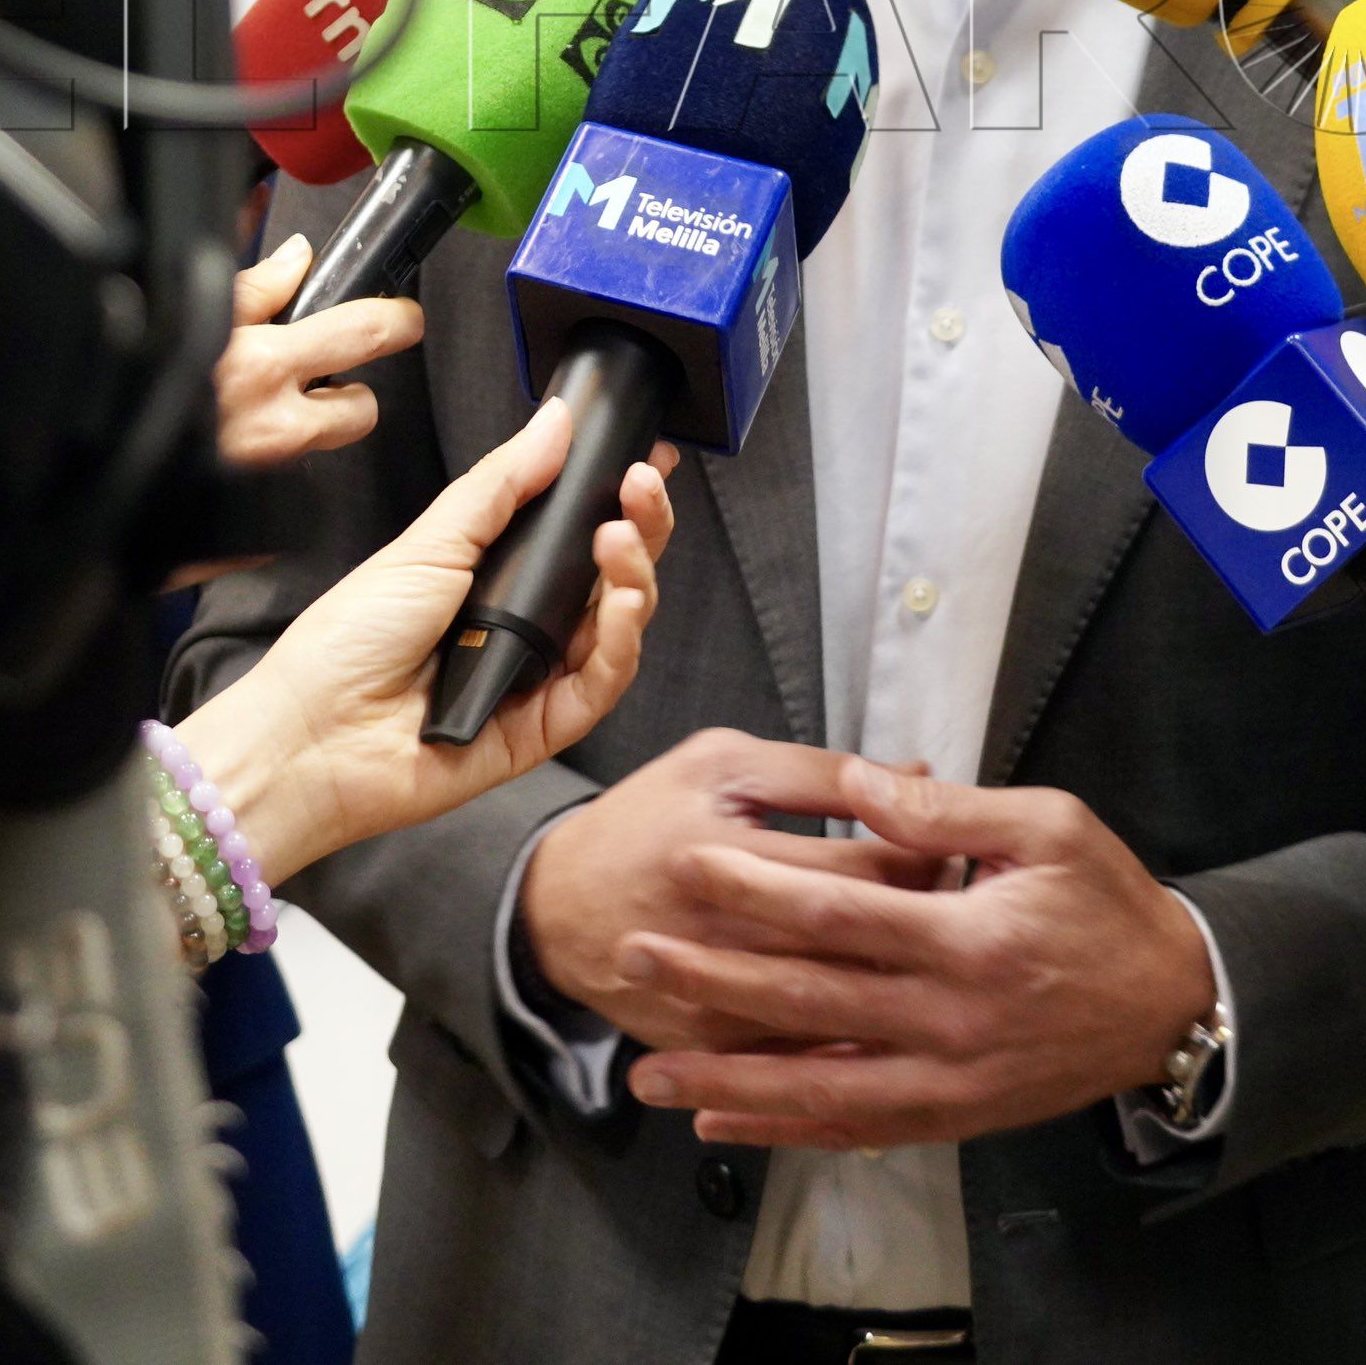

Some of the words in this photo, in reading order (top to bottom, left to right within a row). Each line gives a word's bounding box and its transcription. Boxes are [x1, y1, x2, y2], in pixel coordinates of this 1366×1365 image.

[627, 216, 721, 256] Melilla
[635, 192, 753, 240] Televisión
[1196, 227, 1300, 307] COPE
